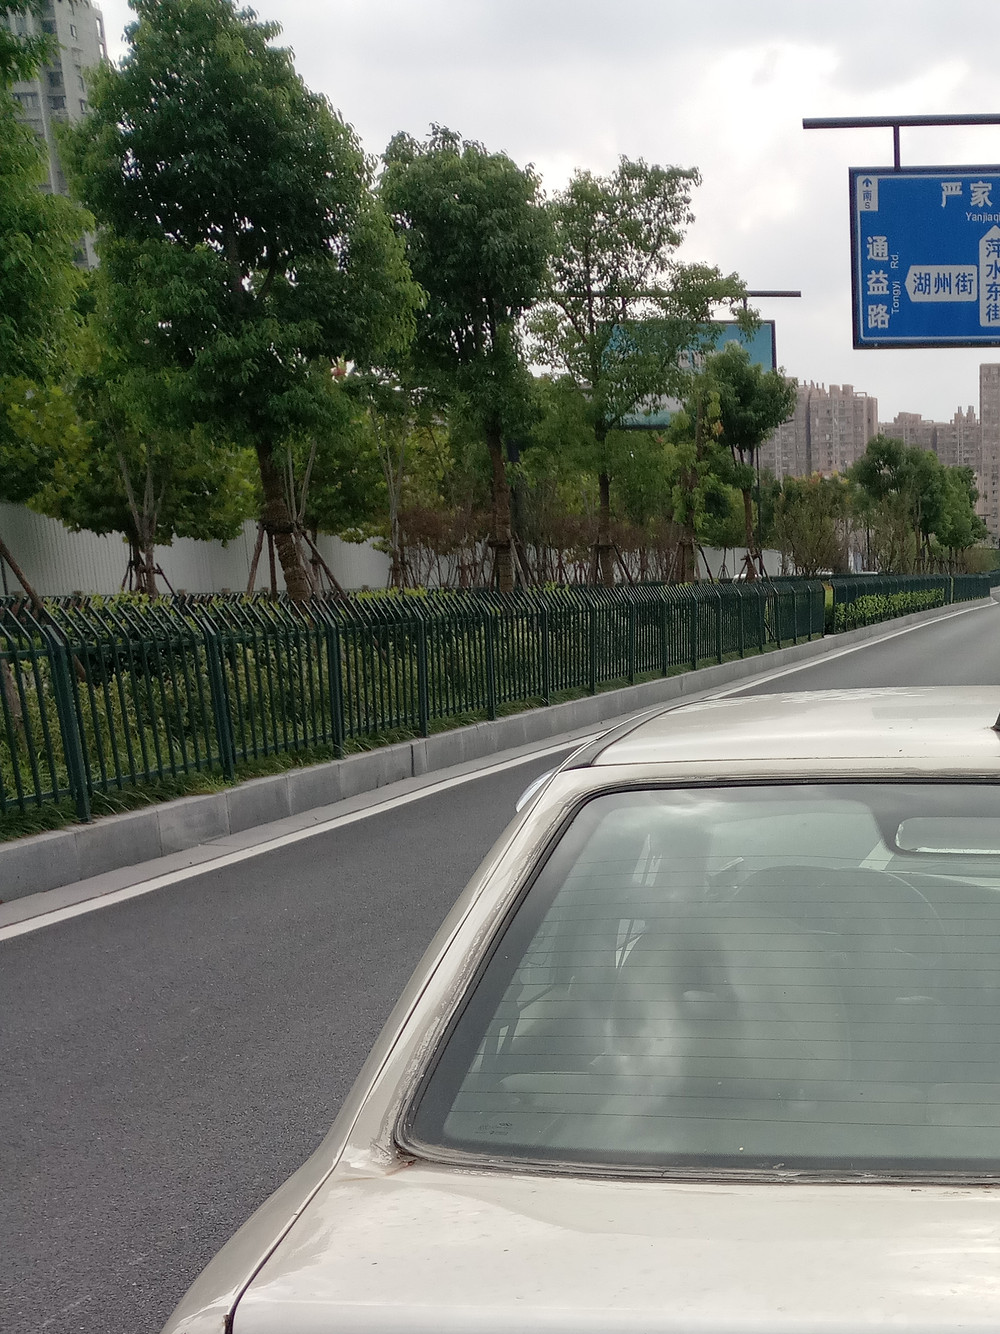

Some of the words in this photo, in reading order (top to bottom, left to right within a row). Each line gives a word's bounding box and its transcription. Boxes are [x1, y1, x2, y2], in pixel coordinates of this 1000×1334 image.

[862, 189, 873, 202] 南
[890, 251, 899, 269] Rd.
[866, 236, 890, 329] 通益路
[912, 272, 975, 296] 湖州街
